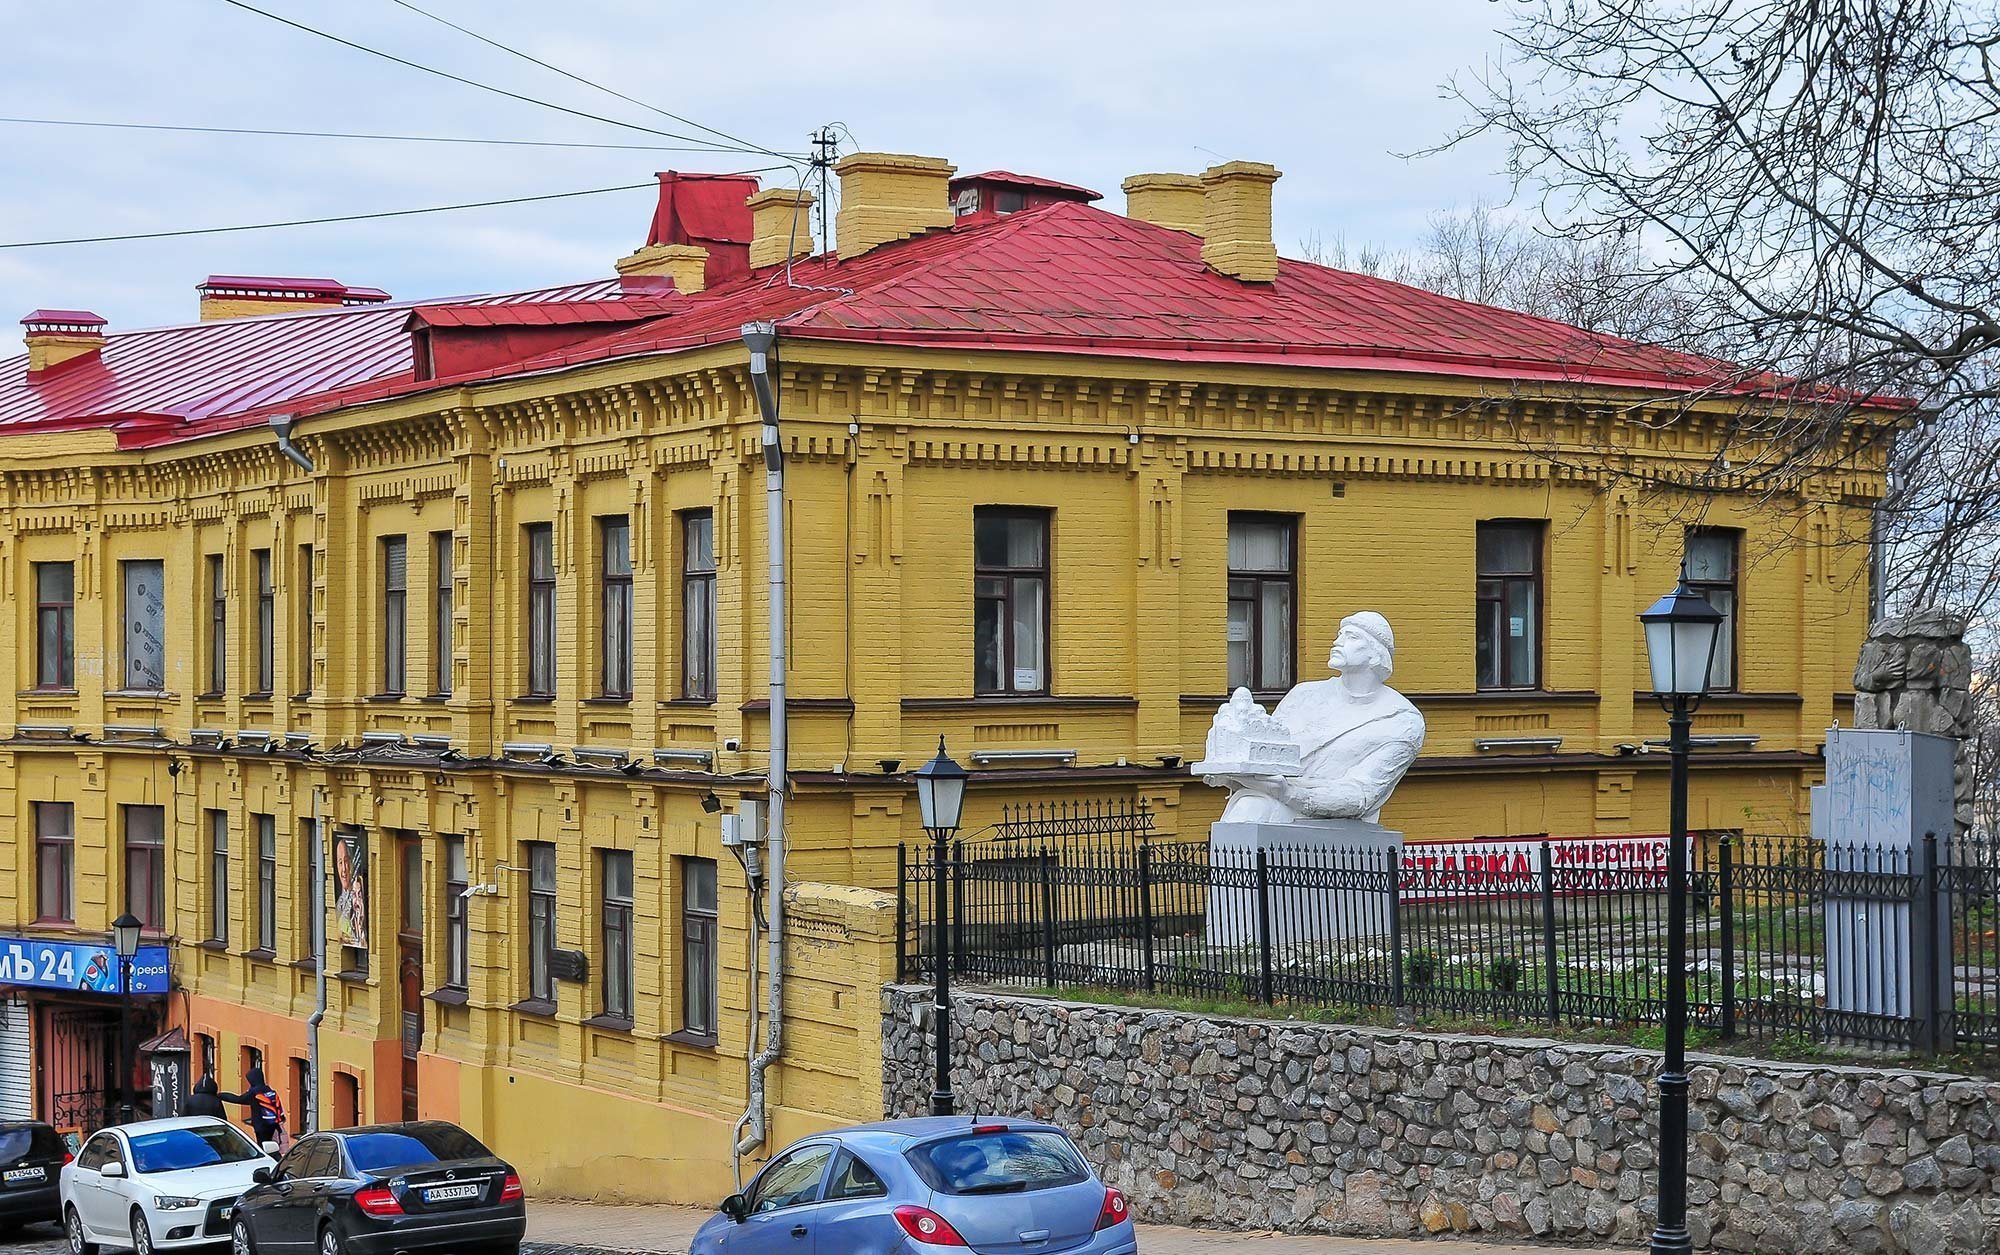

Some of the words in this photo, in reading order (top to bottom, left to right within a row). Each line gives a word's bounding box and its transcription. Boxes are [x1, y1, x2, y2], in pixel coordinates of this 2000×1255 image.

[1554, 842, 1667, 865] ЖИВОПИС
[40, 949, 75, 983] 24
[137, 964, 167, 976] pepsi
[430, 1191, 441, 1200] AA
[444, 1188, 462, 1198] 3337
[464, 1187, 477, 1196] PC
